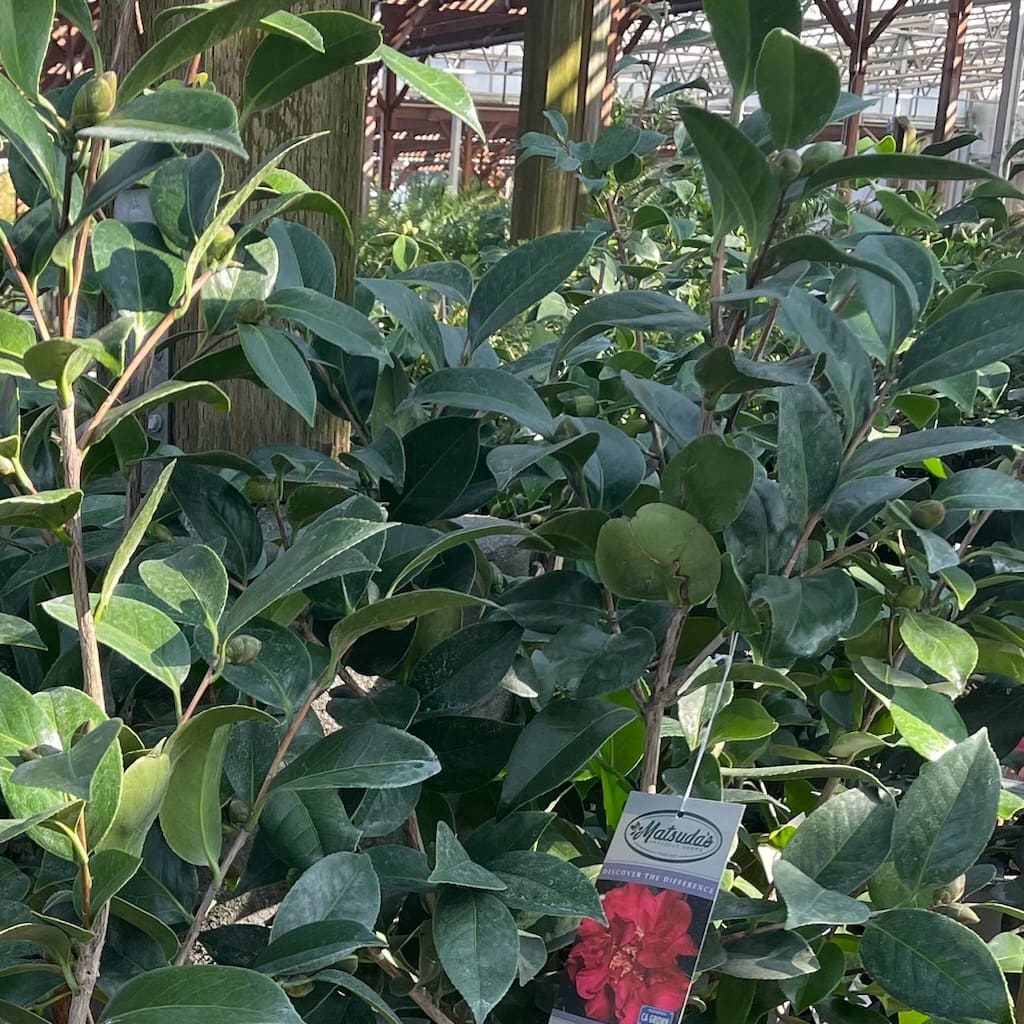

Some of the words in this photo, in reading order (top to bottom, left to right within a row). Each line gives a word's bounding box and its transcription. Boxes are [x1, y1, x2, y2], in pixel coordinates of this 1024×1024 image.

[634, 820, 714, 848] Matsuda's
[602, 867, 641, 879] DISCOVER
[644, 872, 660, 881] THE
[663, 876, 715, 895] DIFFERENCE
